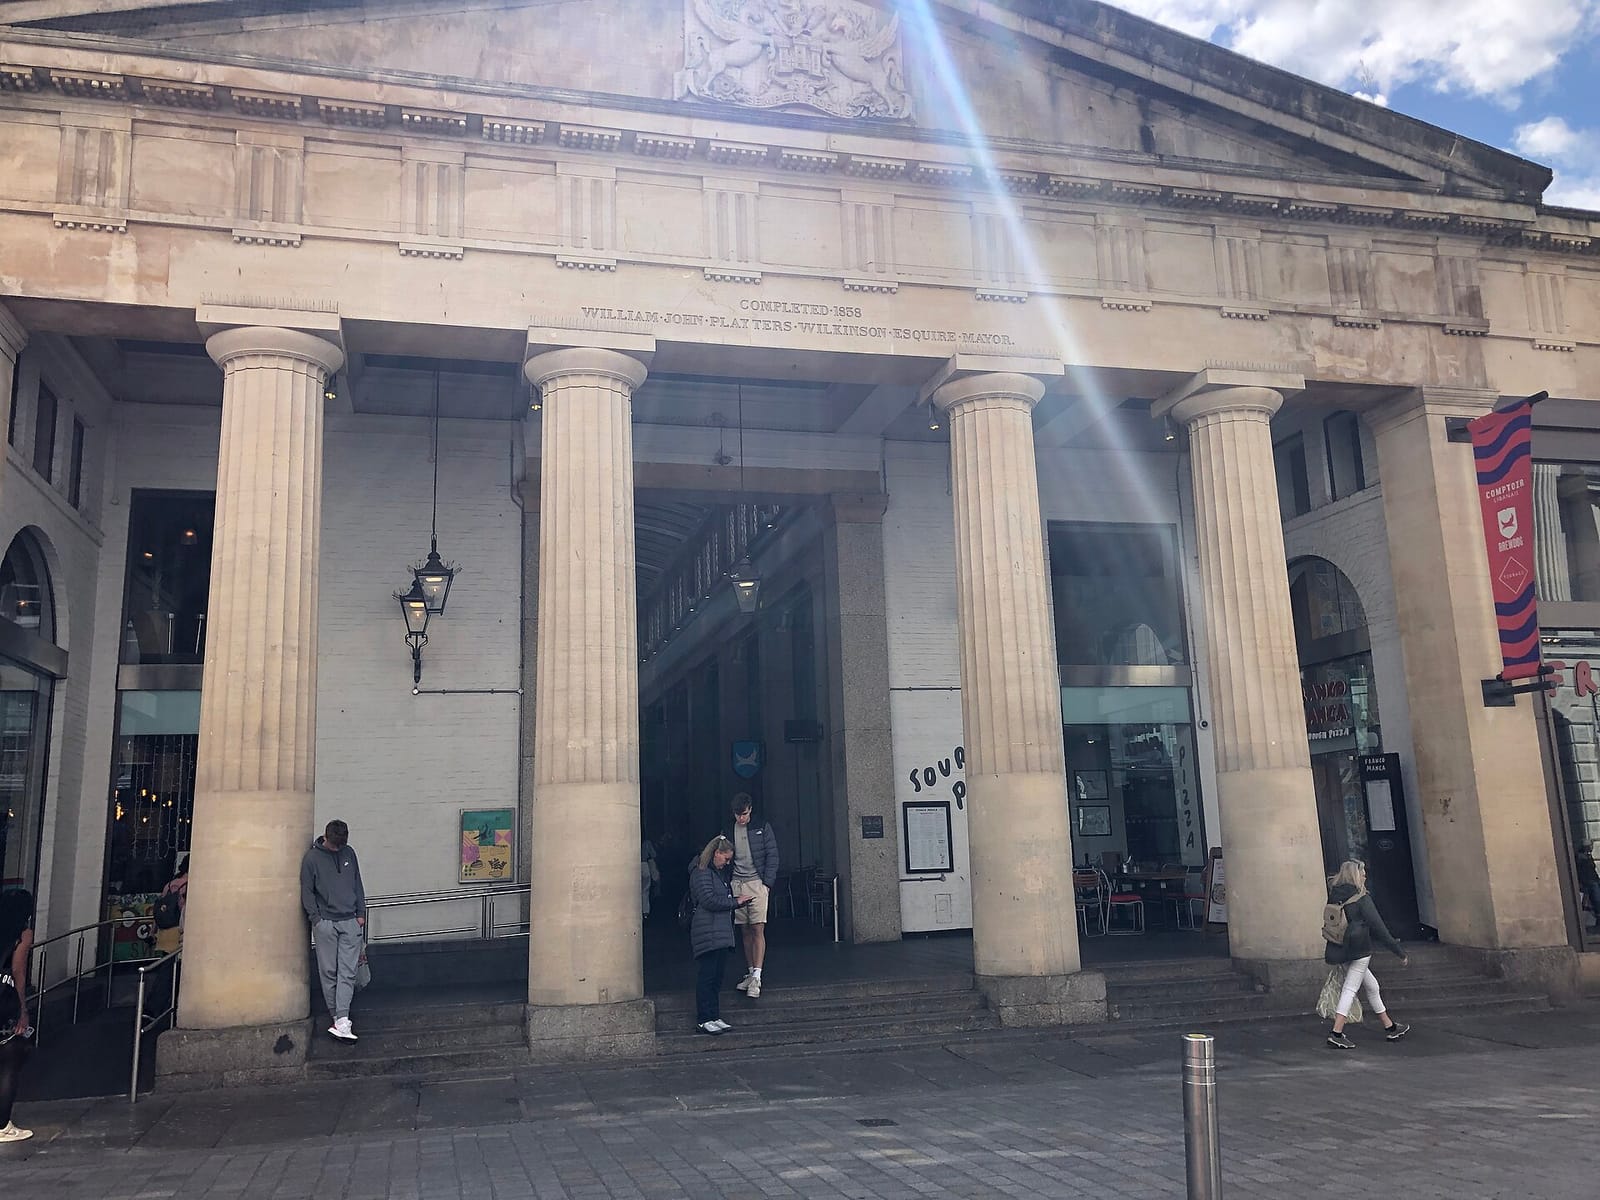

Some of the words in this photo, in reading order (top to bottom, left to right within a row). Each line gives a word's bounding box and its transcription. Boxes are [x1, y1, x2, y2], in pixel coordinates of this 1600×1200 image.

[739, 299, 830, 316] COMPLETED
[833, 305, 863, 318] 1858
[581, 306, 660, 323] WILLIAM
[664, 312, 704, 326] JOHN
[709, 316, 793, 332] PLAYTERS
[797, 322, 887, 338] WILKINSON
[892, 328, 957, 342] ESQUIRE
[1485, 478, 1525, 499] COMPTOIR
[1498, 536, 1524, 552] BREWDOG
[1328, 727, 1350, 739] PIZZA
